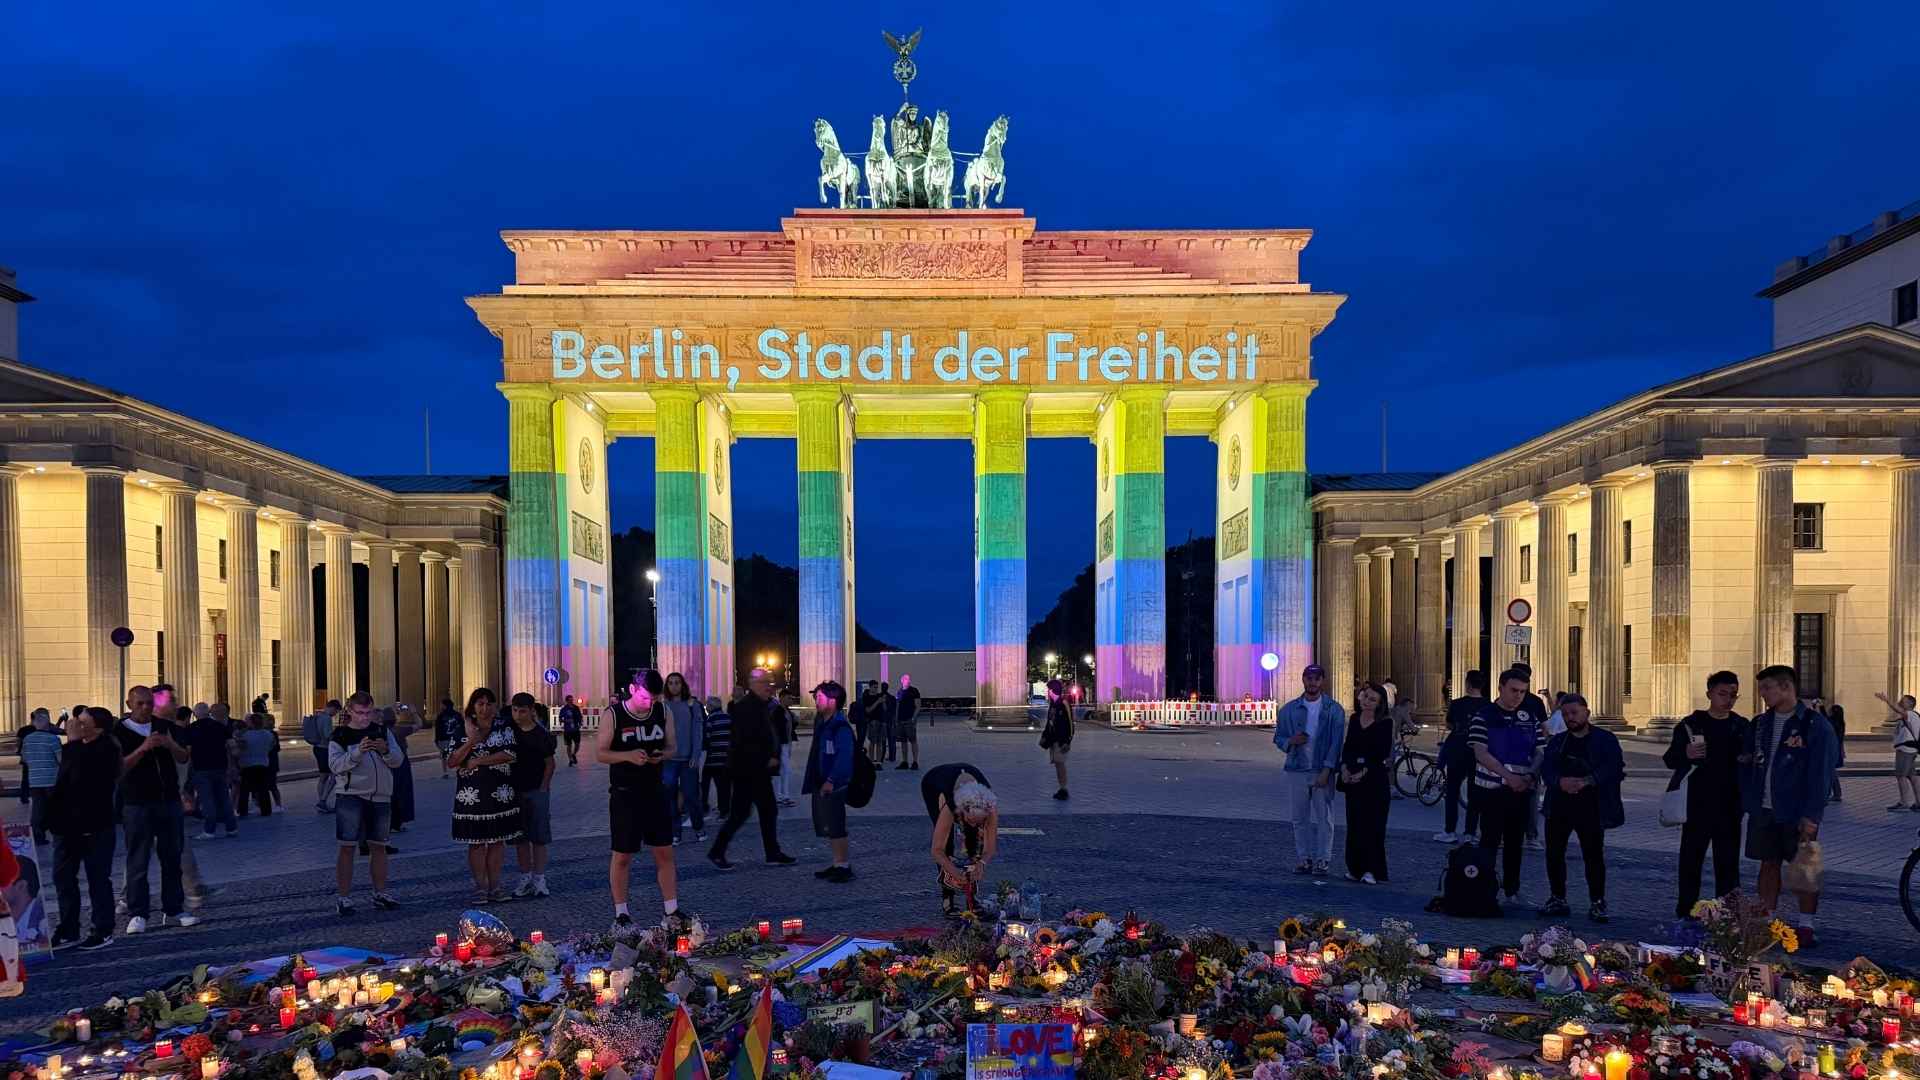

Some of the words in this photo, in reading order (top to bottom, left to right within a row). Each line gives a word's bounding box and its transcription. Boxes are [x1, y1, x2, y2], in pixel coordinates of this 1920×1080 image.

[551, 329, 740, 392] Berlin,
[757, 328, 915, 381] Stadt
[933, 330, 1029, 382] der
[1046, 330, 1260, 382] Freiheit
[621, 724, 664, 742] FILA
[987, 1023, 1065, 1056] LOVE
[985, 1066, 1035, 1080] STONG
